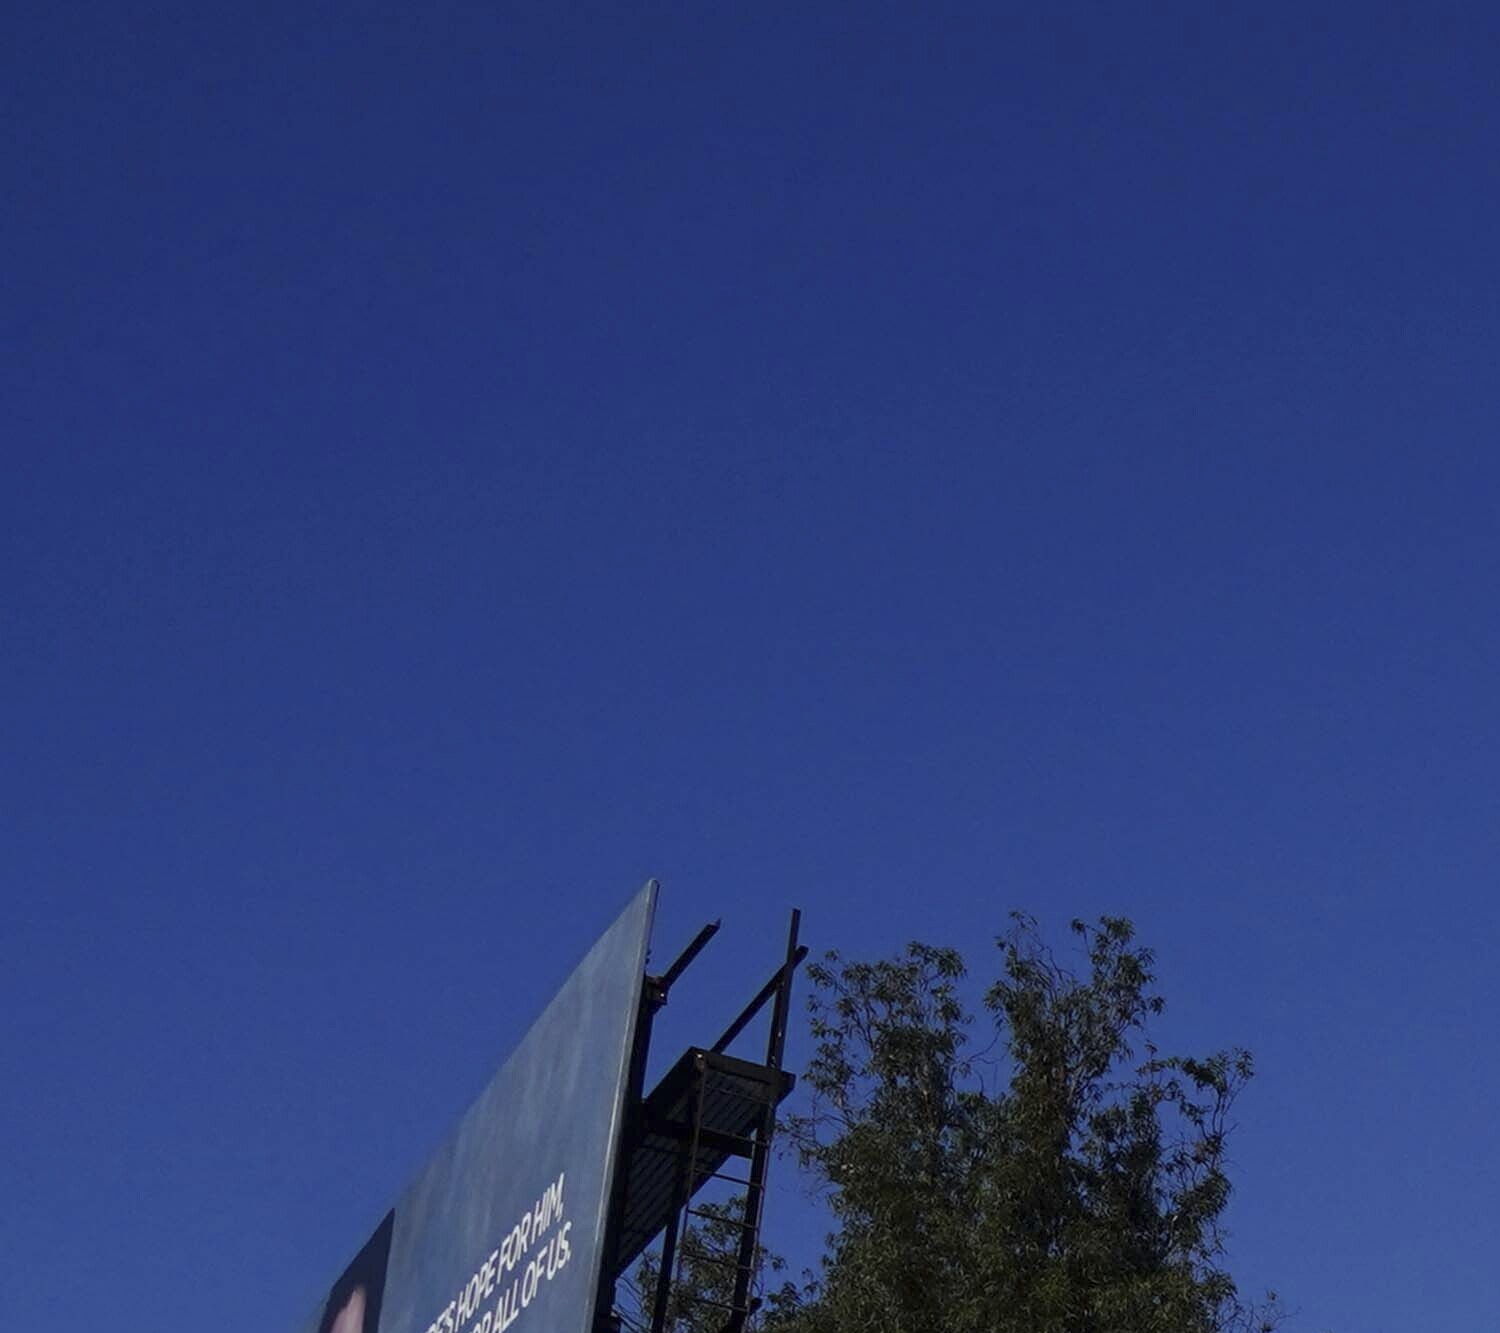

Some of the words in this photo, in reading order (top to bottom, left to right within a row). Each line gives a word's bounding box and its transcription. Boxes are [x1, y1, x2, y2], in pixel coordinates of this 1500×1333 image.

[455, 1250, 499, 1333] HOPE
[497, 1211, 531, 1285] FOR
[521, 1246, 548, 1309] OF
